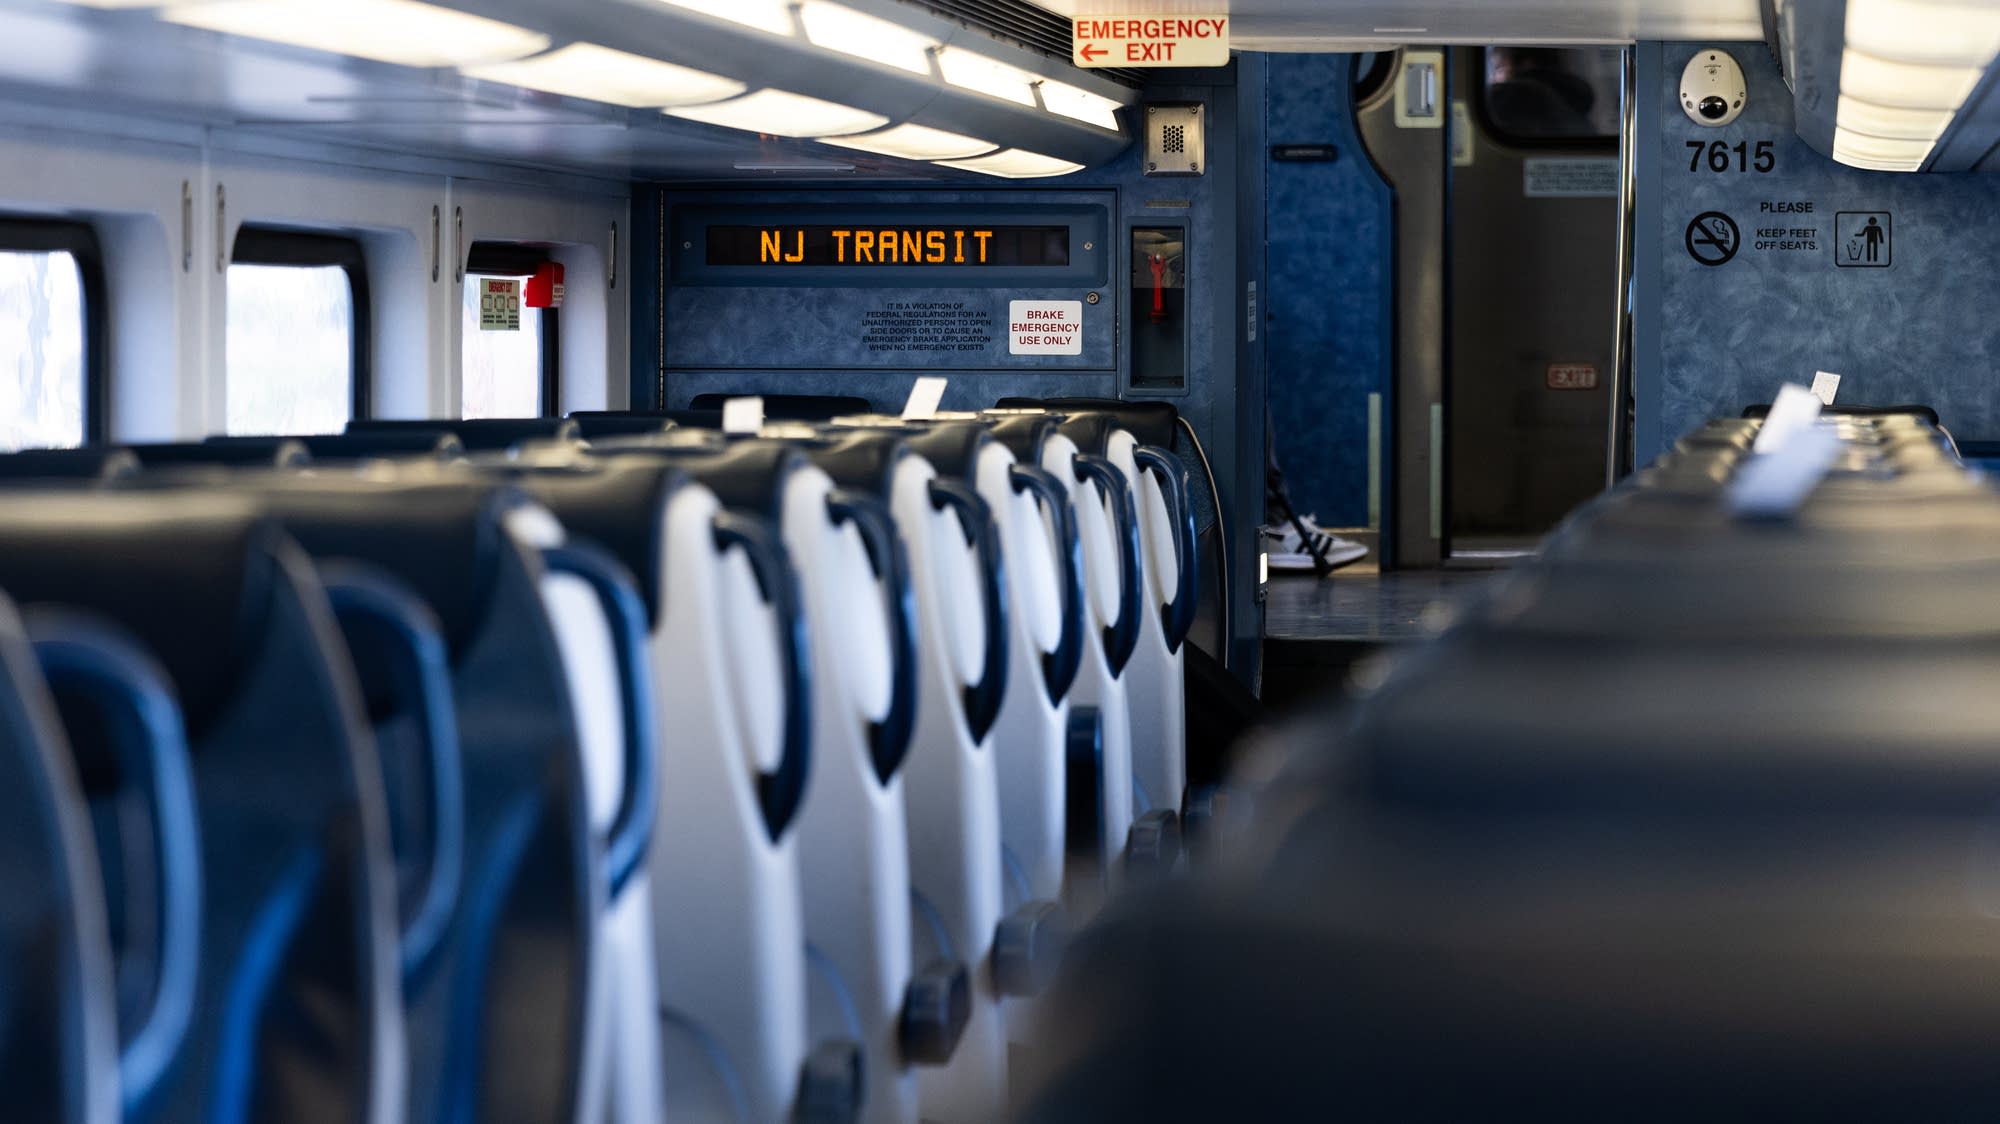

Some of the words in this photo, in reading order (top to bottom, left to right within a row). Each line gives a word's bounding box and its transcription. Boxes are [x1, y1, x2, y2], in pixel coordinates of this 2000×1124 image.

[1077, 20, 1225, 38] EMERGENCY
[1127, 43, 1176, 61] EXIT
[1685, 140, 1775, 173] 7615
[1760, 202, 1813, 213] PLEASE
[1756, 229, 1786, 238] KEEP
[1789, 229, 1817, 238] FEET
[761, 230, 804, 262] NJ
[832, 230, 992, 262] TRANSIT
[1755, 241, 1777, 250] OFF
[1780, 241, 1818, 250] SEATS.
[1027, 311, 1064, 319] BRAKE
[1012, 324, 1079, 332] EMERGENCY
[1020, 336, 1040, 345] USE
[1044, 336, 1072, 345] ONLY
[1550, 369, 1594, 386] EXIT
